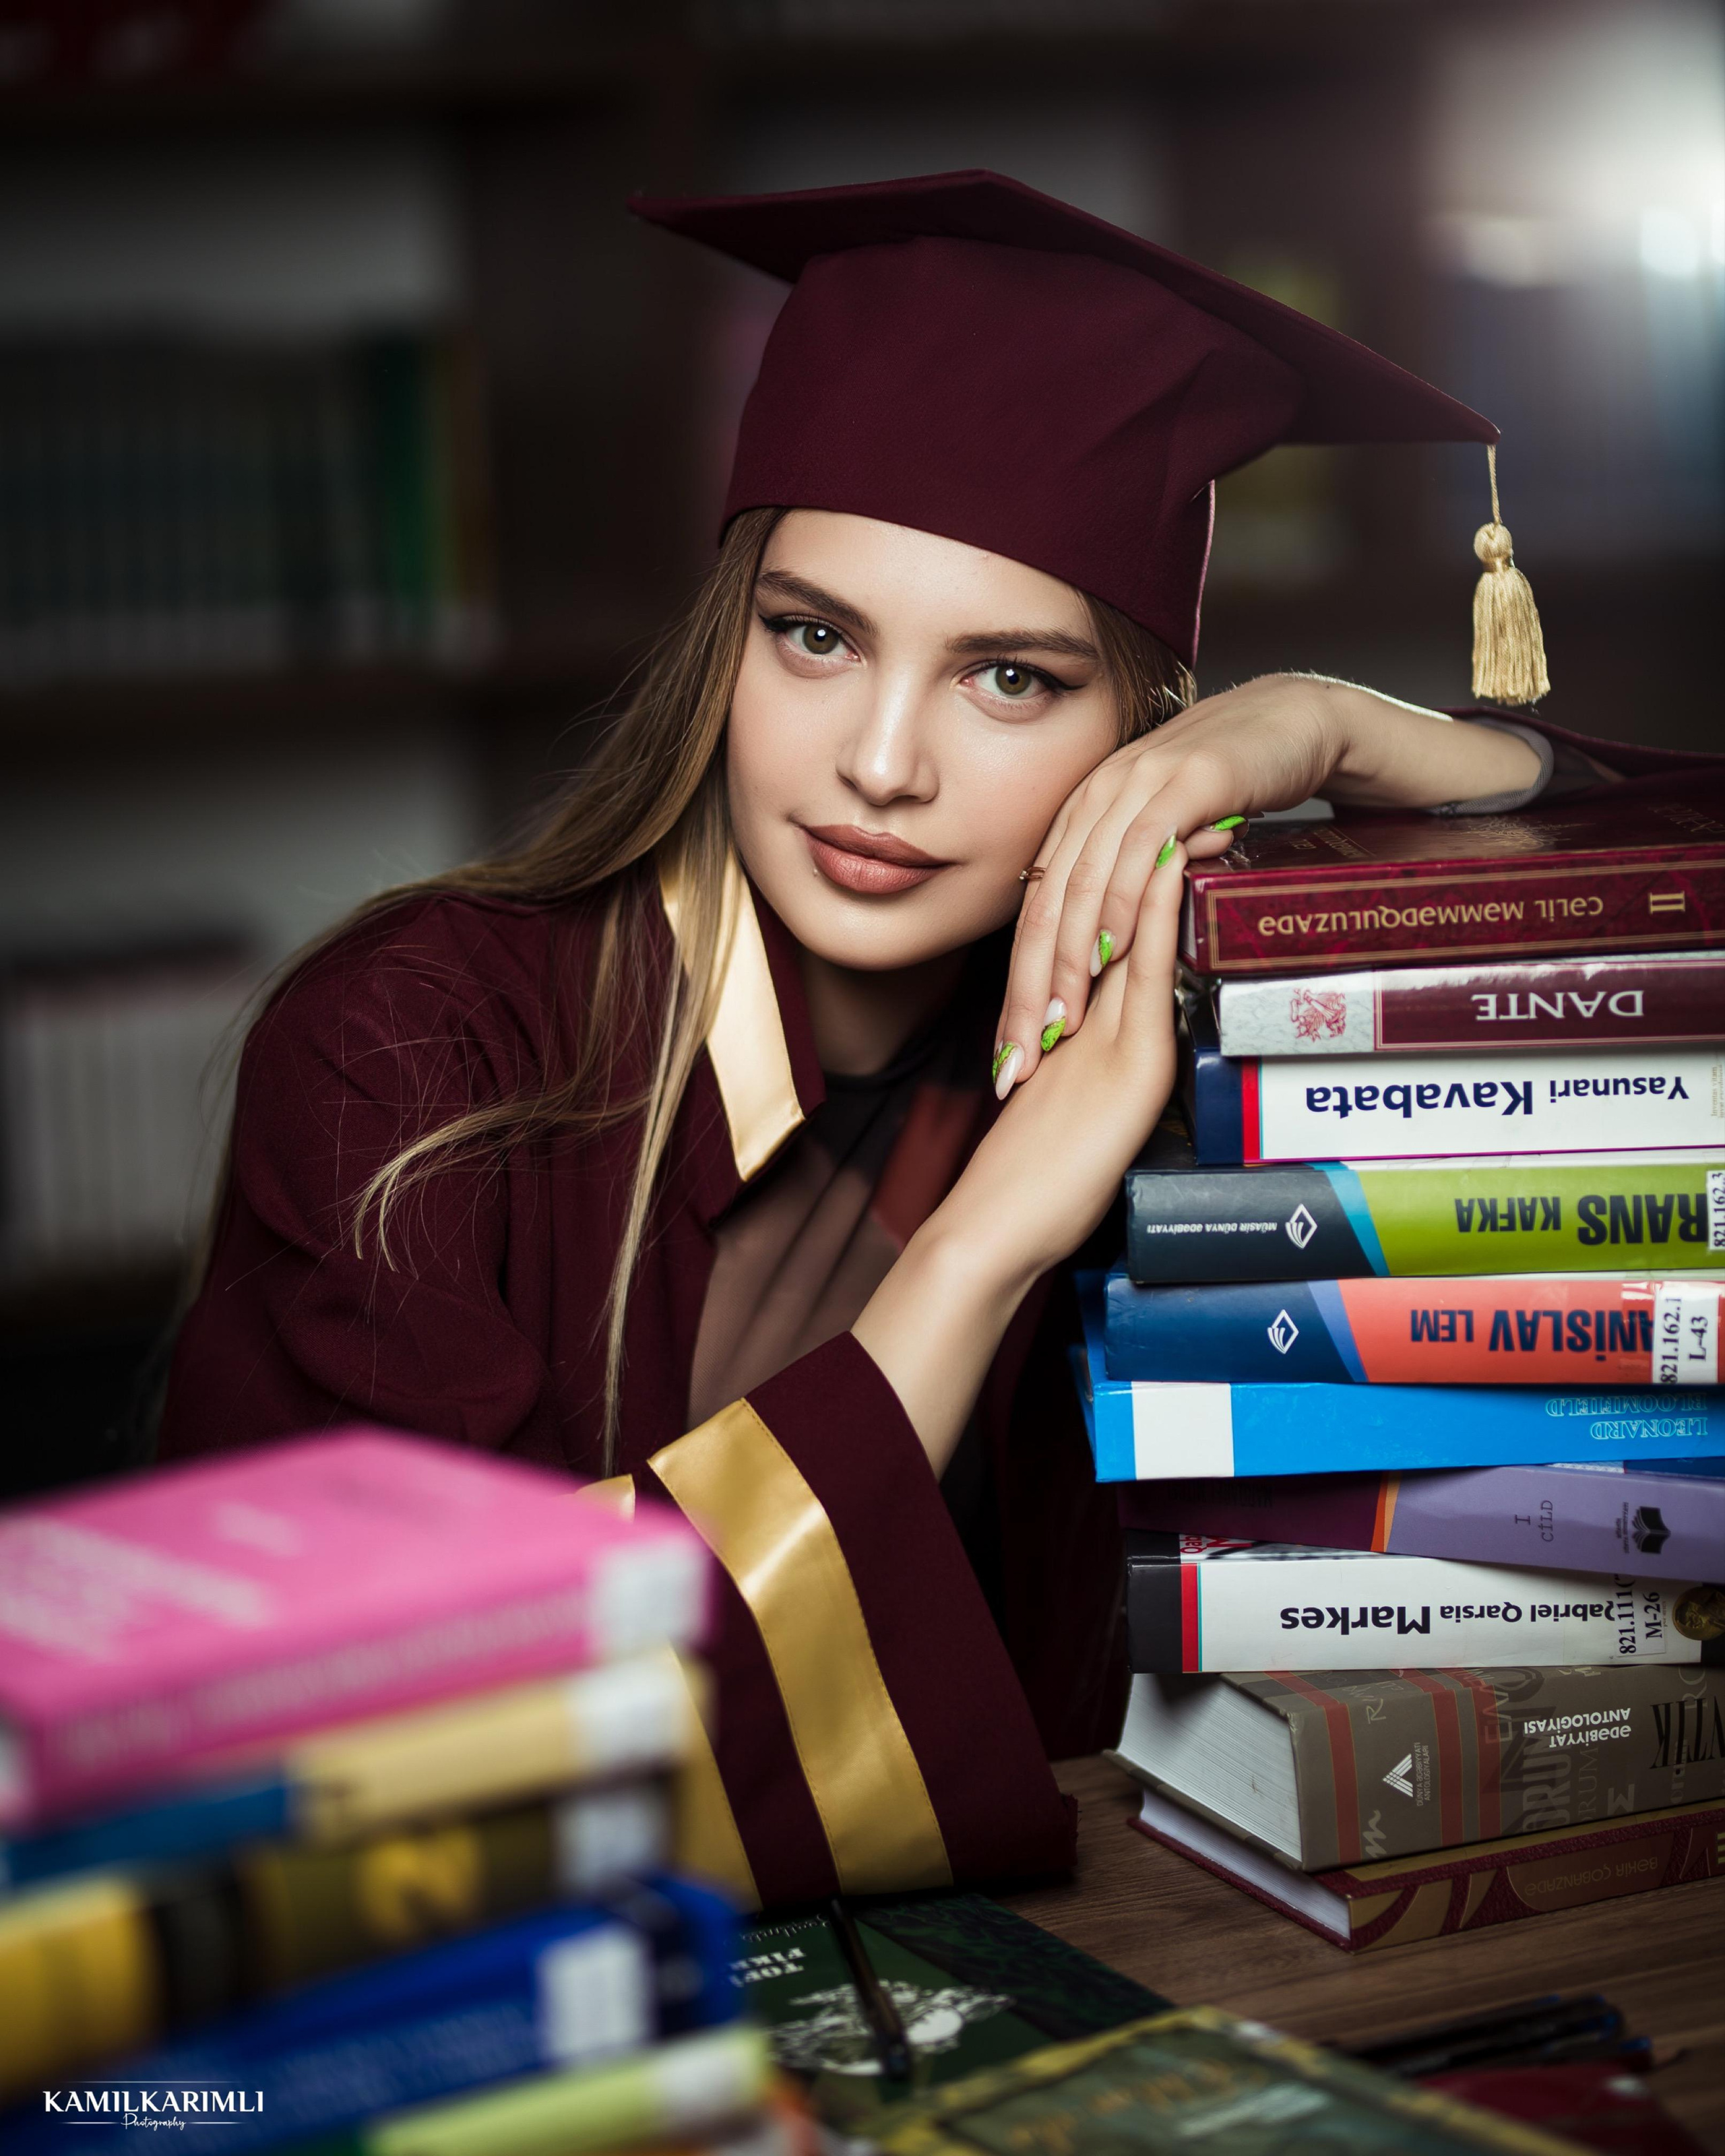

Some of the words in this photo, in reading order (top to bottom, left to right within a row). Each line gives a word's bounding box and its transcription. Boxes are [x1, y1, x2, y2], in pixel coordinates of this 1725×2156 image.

[1472, 990, 1644, 1021] DANTE
[1306, 1079, 1534, 1118] Kavabata
[1550, 1076, 1689, 1103] Yasunari
[1205, 1223, 1238, 1234] DÜNYA
[1238, 1222, 1278, 1234] MÜASİR
[1455, 1196, 1561, 1232] KAFKA
[1577, 1193, 1707, 1246] RANS
[1410, 1309, 1474, 1342] LEM
[1488, 1309, 1654, 1362] ANİSLAV
[1689, 1316, 1709, 1362] L-43
[1545, 1392, 1707, 1417] BLOOMFIELD
[1590, 1416, 1708, 1440] LEONARD
[1281, 1605, 1431, 1636] Markes
[1440, 1602, 1523, 1623] Qarsia
[1531, 1599, 1615, 1622] Qabriel
[1643, 1592, 1663, 1639] M-26
[1524, 1707, 1631, 1734] ANTOLOGİYASI
[1649, 1694, 1725, 1770] NTİK
[1549, 1725, 1631, 1748] ƏDƏBİYYAT
